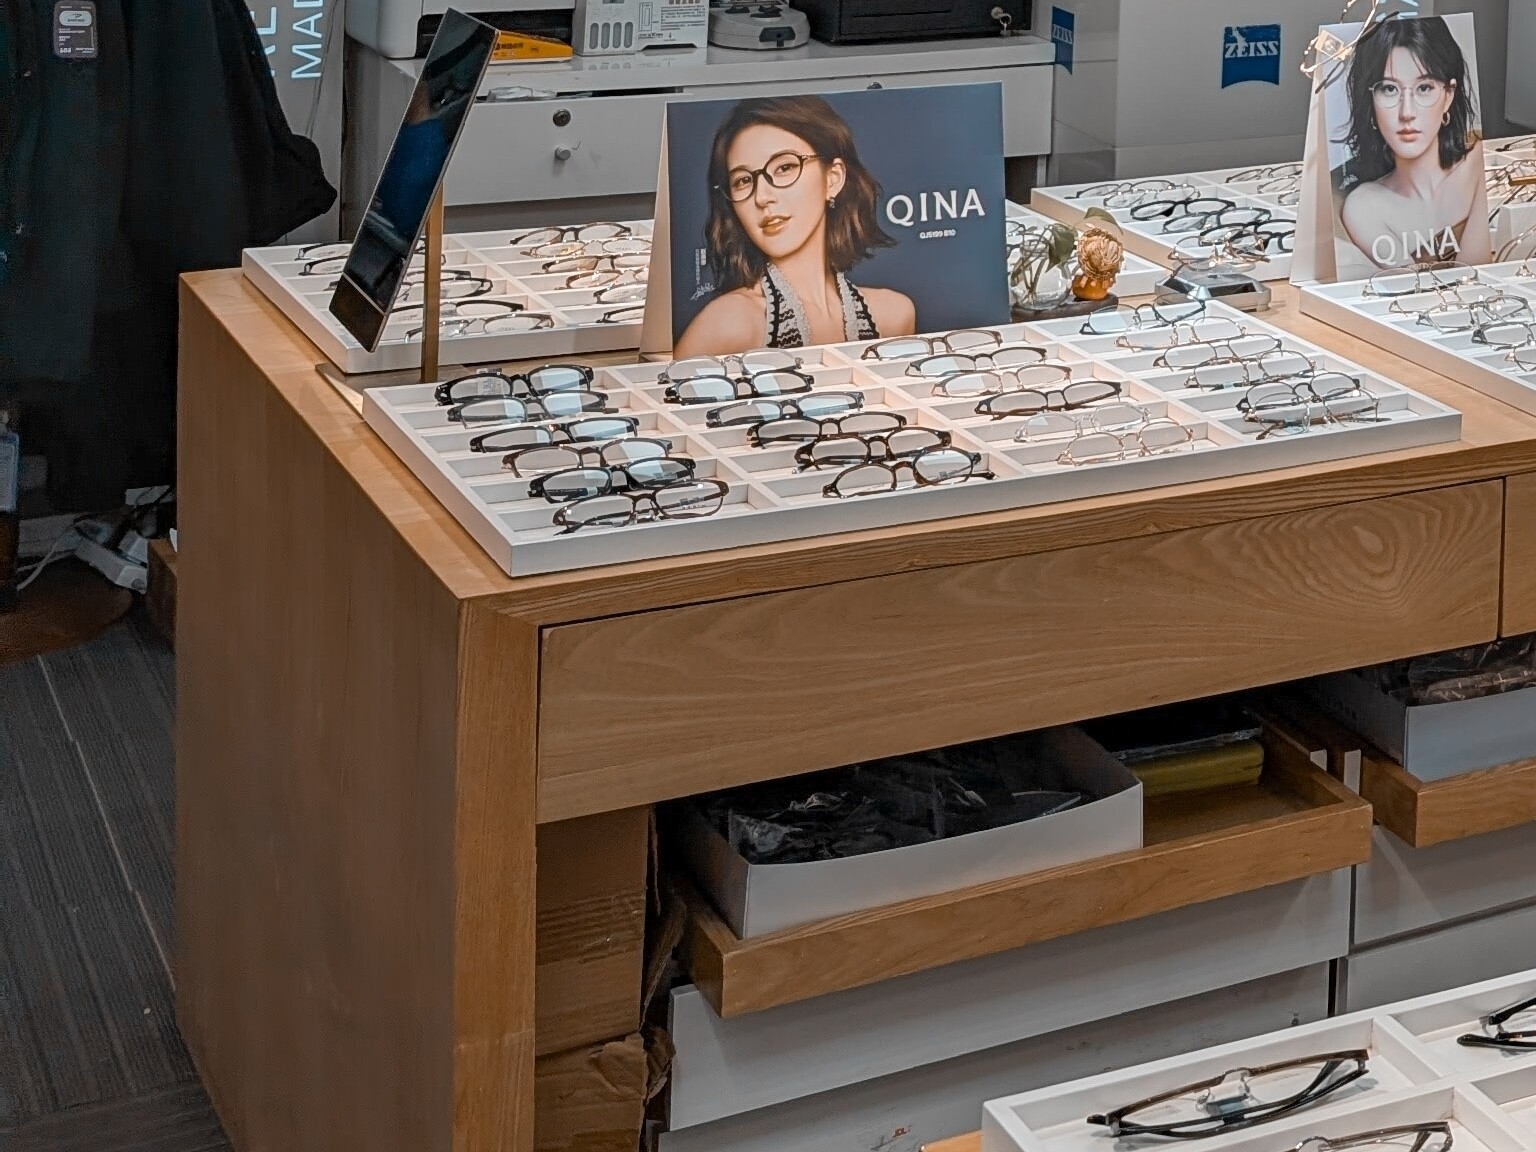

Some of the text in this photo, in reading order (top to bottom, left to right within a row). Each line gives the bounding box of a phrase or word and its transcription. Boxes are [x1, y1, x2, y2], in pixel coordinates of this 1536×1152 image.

[1052, 23, 1073, 45] ZEISS
[1224, 40, 1279, 59] ZEISS
[886, 188, 986, 227] QINA
[1372, 225, 1461, 266] QINA
